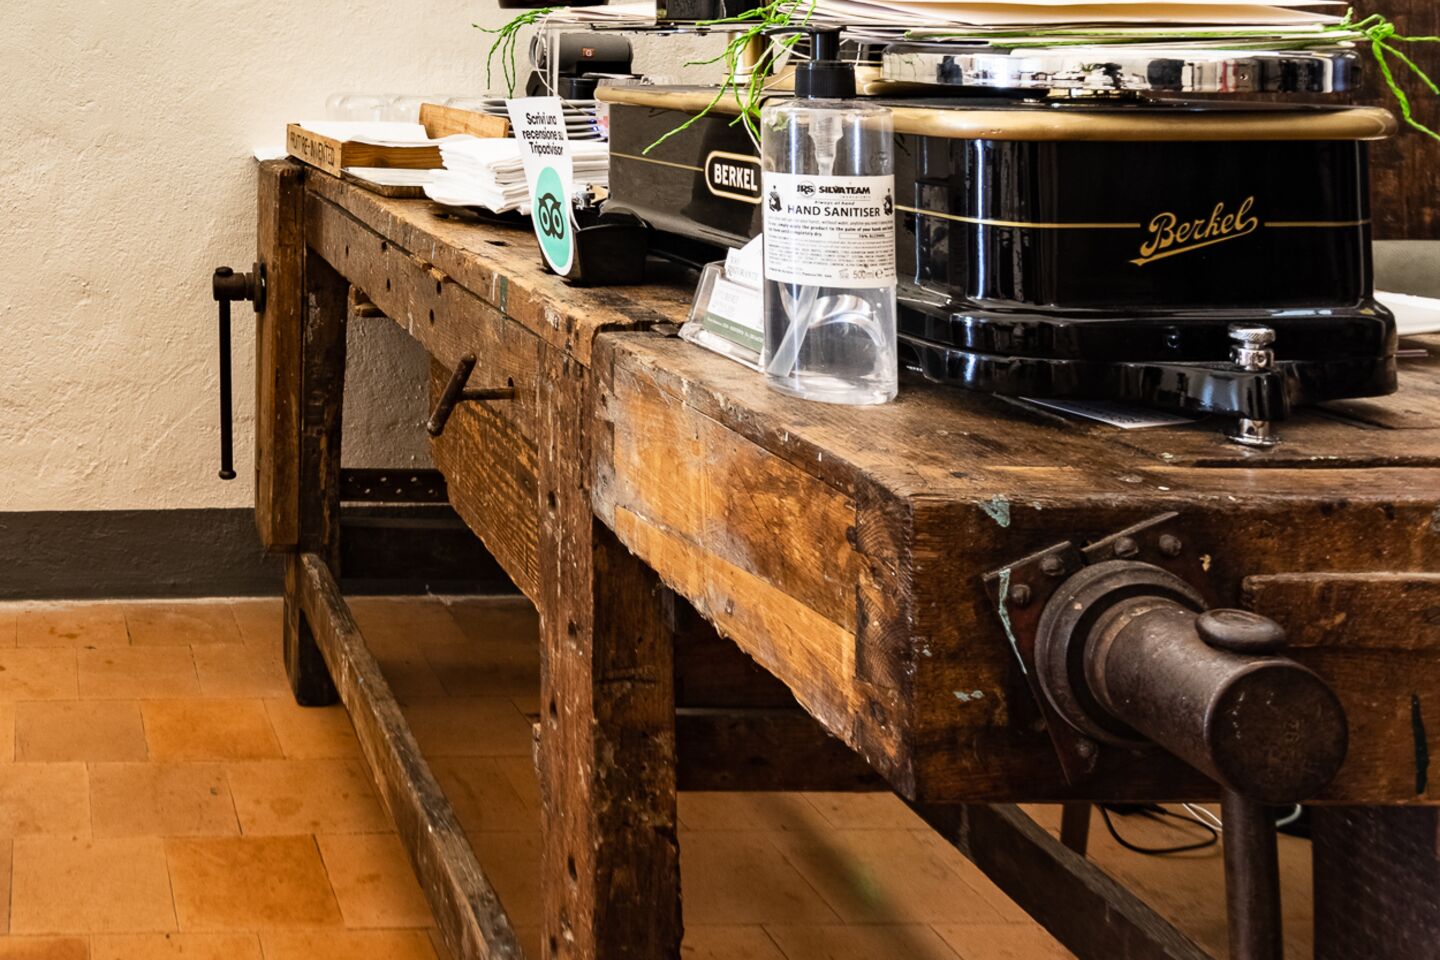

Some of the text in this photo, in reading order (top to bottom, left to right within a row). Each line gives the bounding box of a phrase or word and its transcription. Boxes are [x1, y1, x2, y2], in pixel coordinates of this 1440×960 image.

[528, 141, 564, 157] Tripadvisor
[713, 163, 759, 192] BERKEL
[787, 204, 880, 217] HAND SANITISER
[1129, 196, 1258, 266] Berkel
